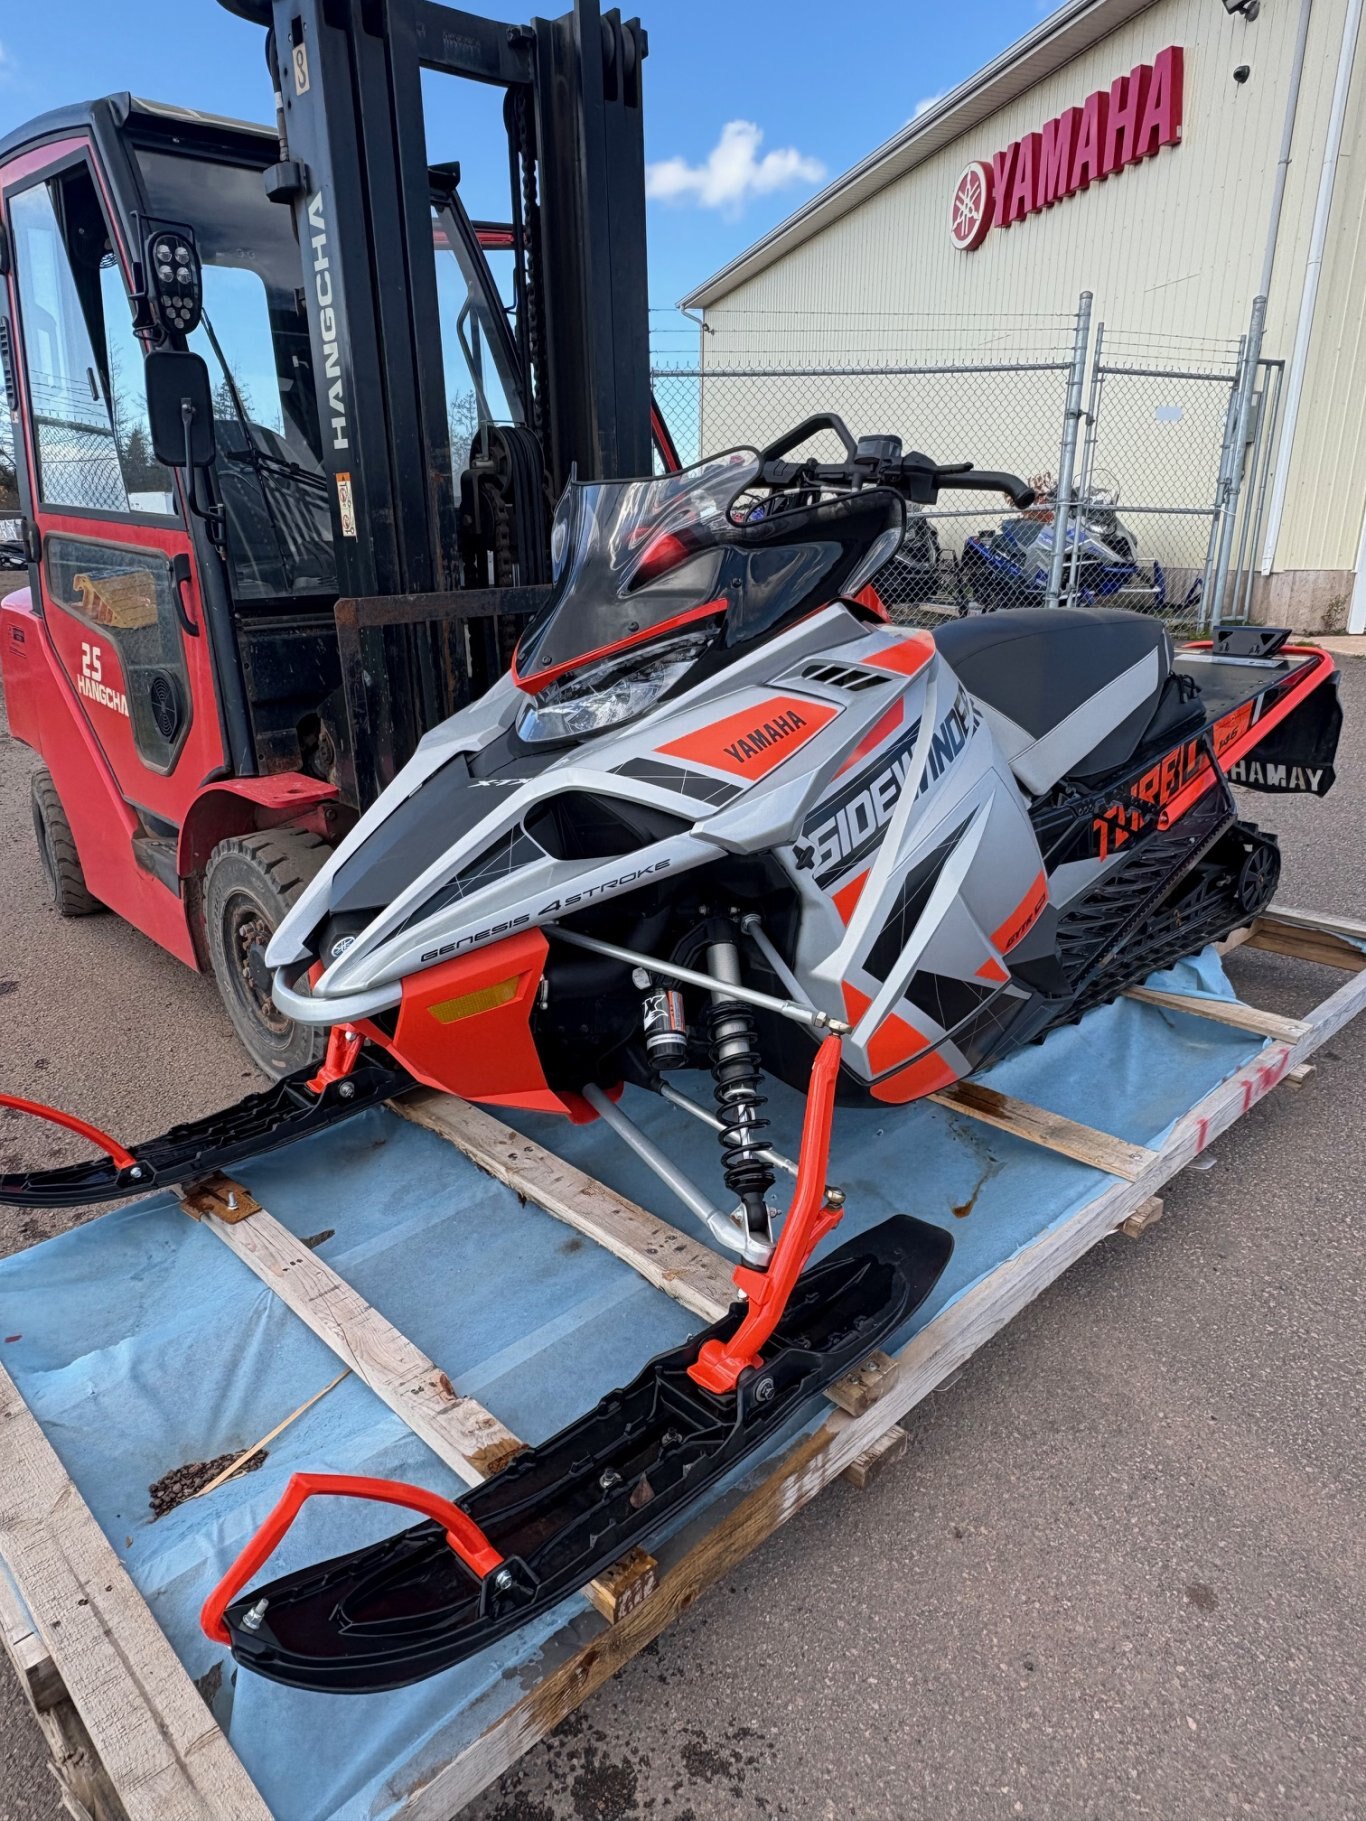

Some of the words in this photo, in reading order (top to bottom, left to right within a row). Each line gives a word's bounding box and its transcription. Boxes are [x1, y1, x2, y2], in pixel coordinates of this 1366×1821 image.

[992, 45, 1184, 229] YAMAHA
[308, 190, 349, 450] HANGCHA
[81, 641, 102, 683] 25
[77, 673, 130, 718] HANGCHA
[723, 710, 807, 763] YAMAHA
[420, 913, 531, 964] GENESIS
